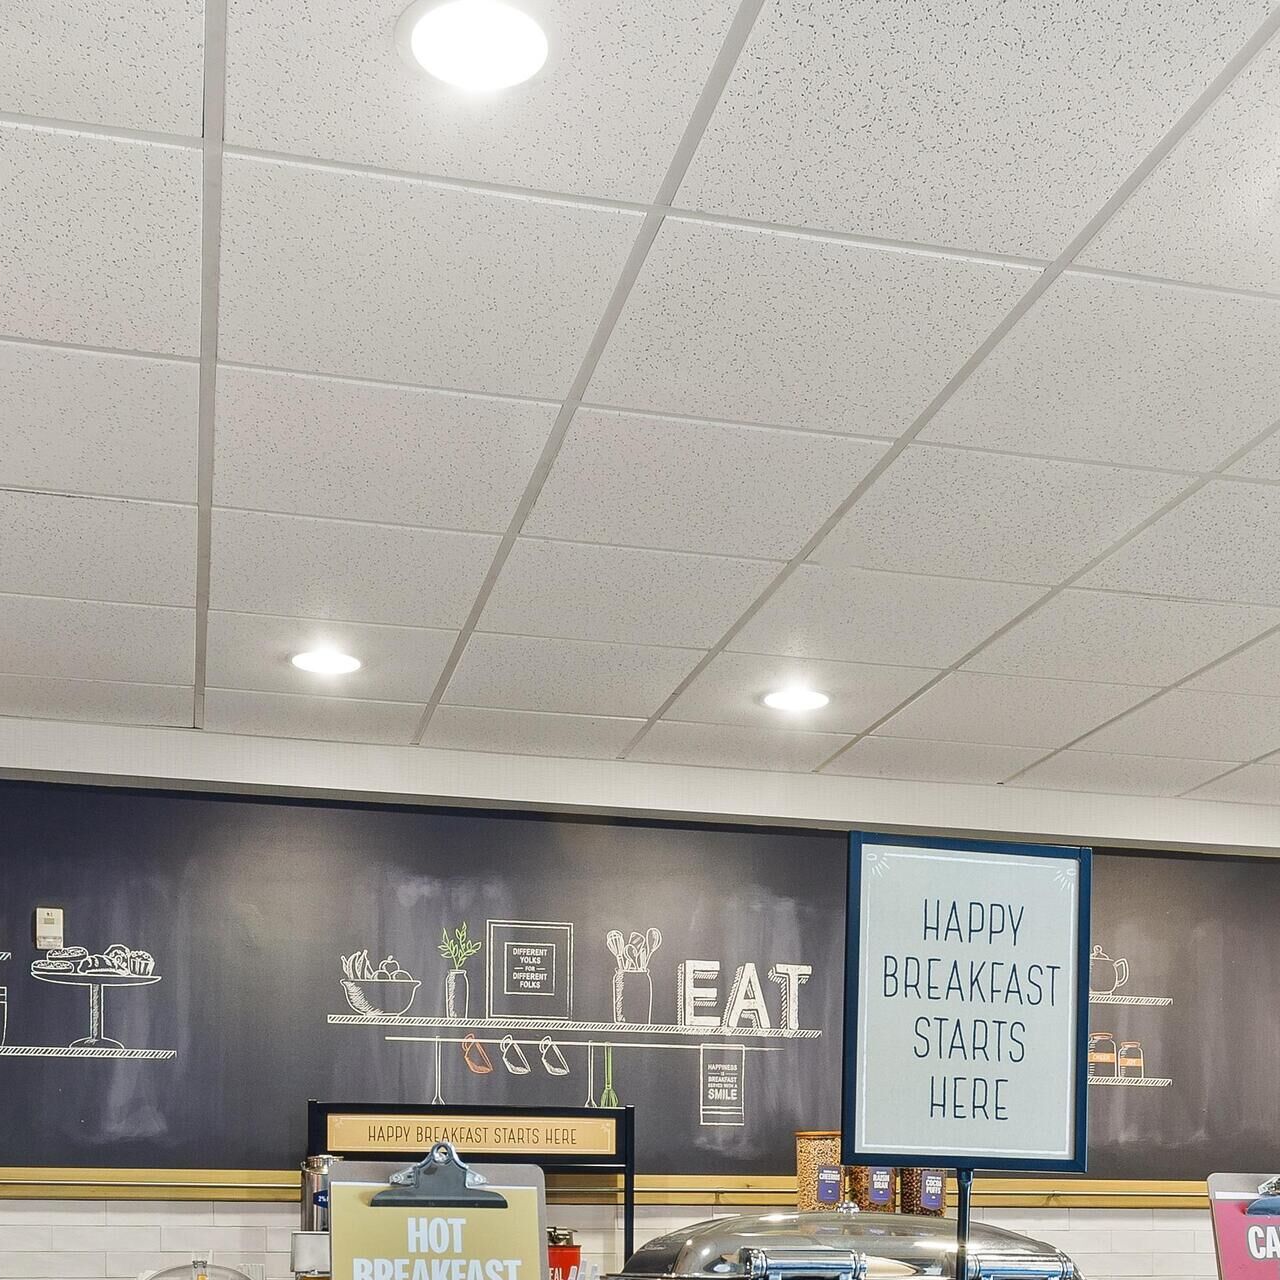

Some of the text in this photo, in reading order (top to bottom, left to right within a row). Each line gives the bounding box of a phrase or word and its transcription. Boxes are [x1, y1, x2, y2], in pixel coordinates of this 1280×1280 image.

[923, 899, 1024, 946] HAPPY
[512, 948, 548, 956] DIFFERENT
[512, 972, 548, 980] DIFFERENT
[520, 981, 541, 989] FOLKS
[678, 959, 813, 1030] EAT
[883, 955, 1061, 1007] BREAKFAST
[913, 1016, 1026, 1063] STARTS
[707, 1088, 738, 1101] SMILE
[930, 1075, 1009, 1120] HERE
[368, 1126, 577, 1145] HAPPY BREAKFAST STARTS HERE
[407, 1217, 467, 1254] HOT
